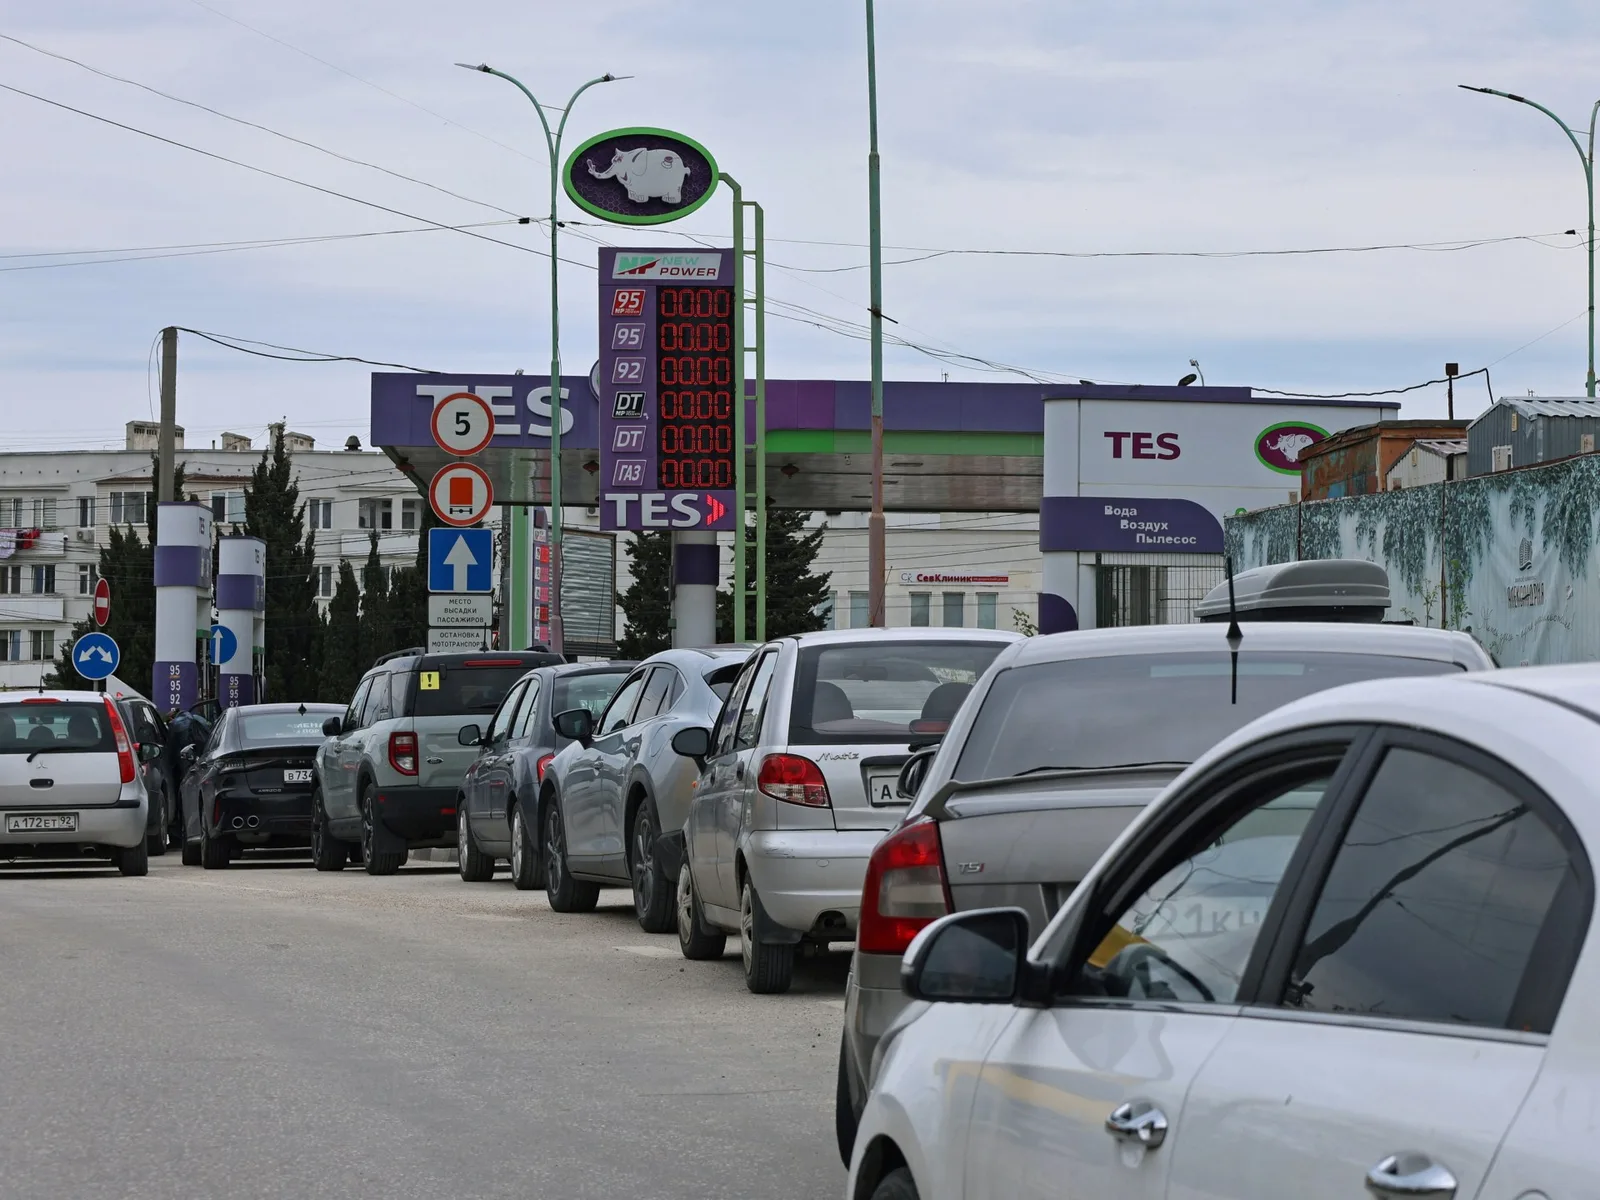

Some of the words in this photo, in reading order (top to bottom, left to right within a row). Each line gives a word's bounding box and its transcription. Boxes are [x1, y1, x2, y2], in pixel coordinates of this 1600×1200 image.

[662, 257, 699, 265] NEW
[660, 267, 716, 276] POWER
[618, 292, 640, 308] 95
[618, 328, 640, 344] 95
[618, 362, 640, 378] 92
[617, 394, 642, 410] DT
[416, 384, 574, 437] TES
[455, 411, 470, 436] 5
[617, 431, 642, 447] DT
[1104, 431, 1181, 460] TES
[618, 465, 641, 481] ГАЗ
[605, 493, 701, 527] TES
[1104, 505, 1137, 517] Вода
[1120, 519, 1168, 532] Воздух
[1136, 533, 1197, 544] Пылесос
[444, 607, 477, 615] ВЫСАДКИ
[169, 664, 181, 676] 95
[170, 680, 181, 691] 95
[229, 676, 239, 686] 95
[169, 693, 181, 705] 92
[229, 689, 239, 699] 95
[816, 752, 860, 762] Matiz
[60, 816, 71, 825] 92
